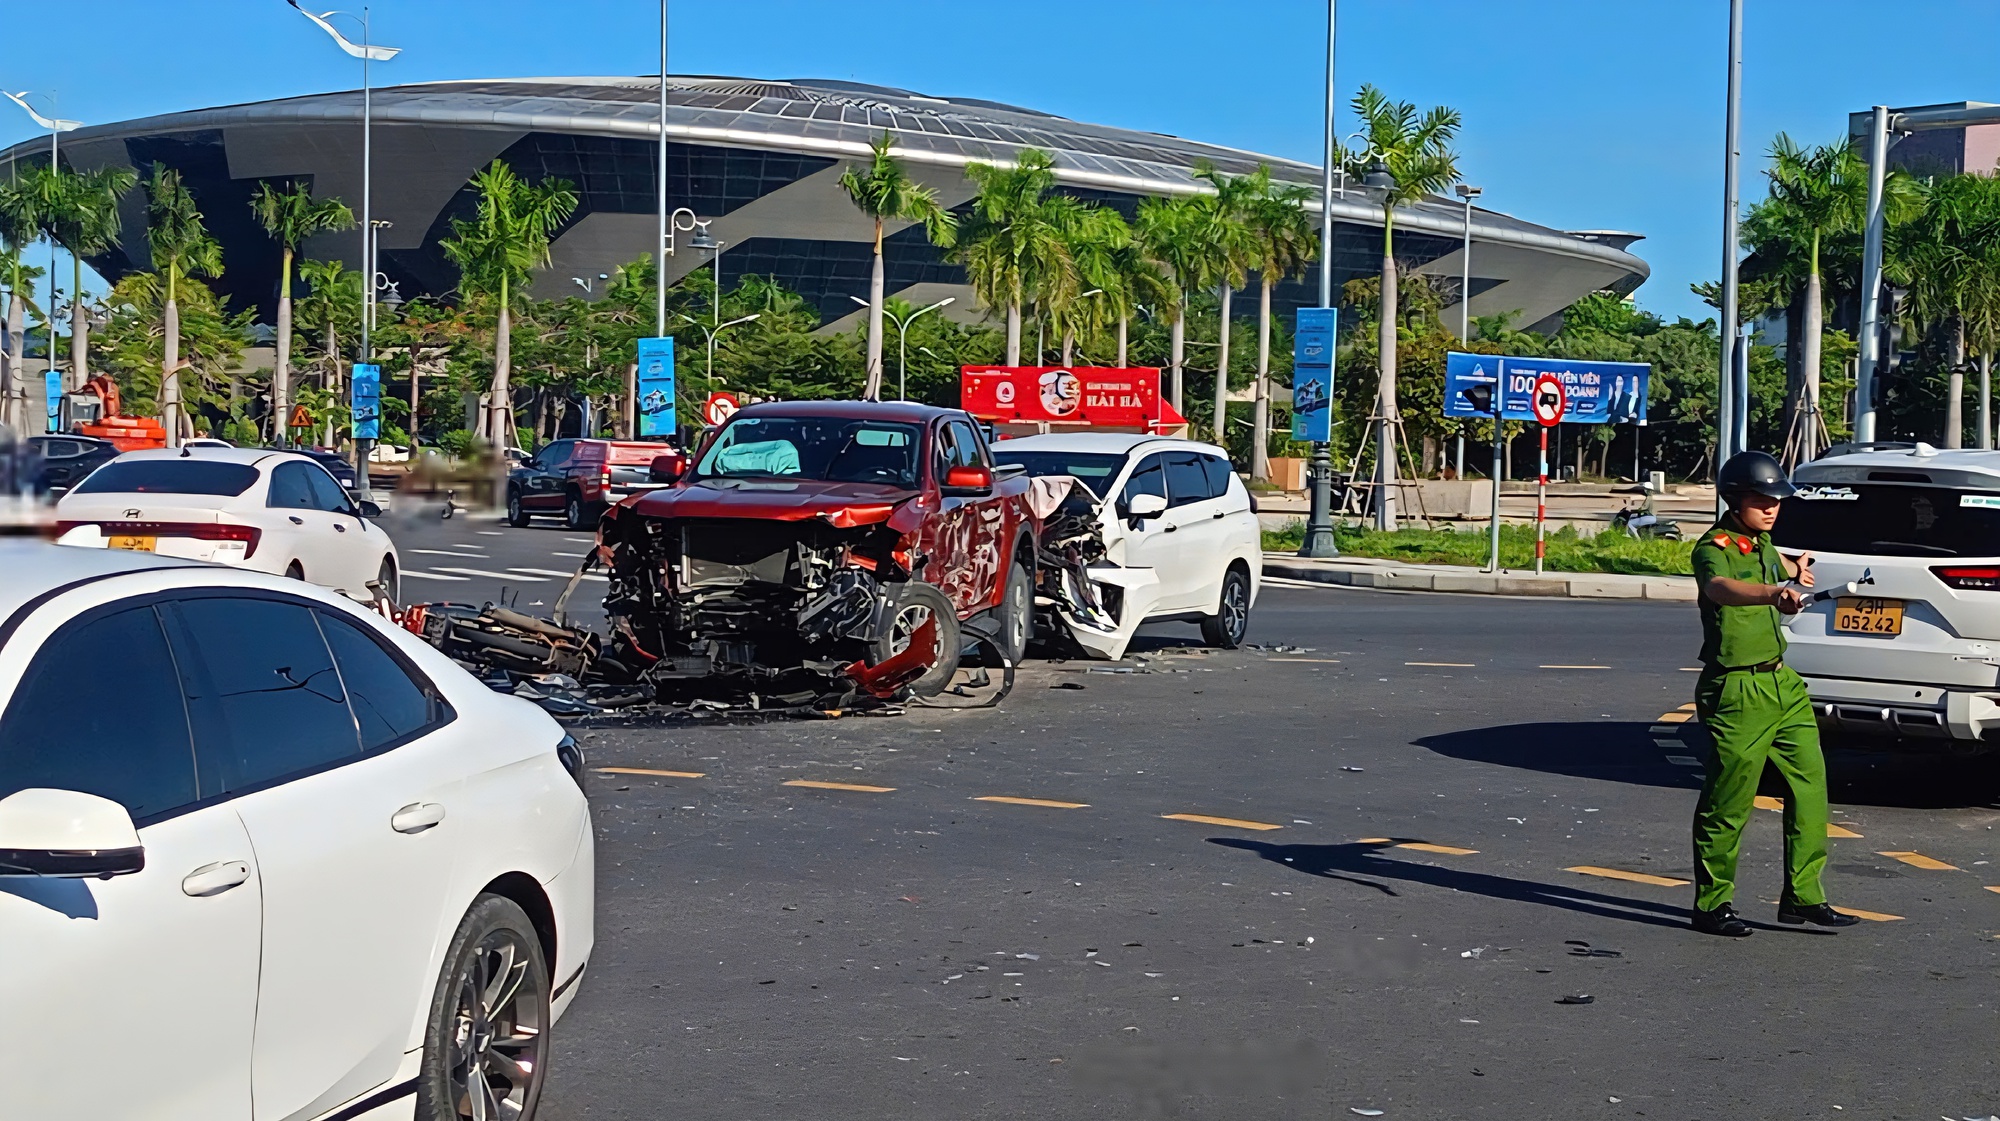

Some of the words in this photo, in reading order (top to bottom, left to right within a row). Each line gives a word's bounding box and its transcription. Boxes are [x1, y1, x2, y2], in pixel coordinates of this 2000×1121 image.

[1510, 375, 1536, 394] 100
[1540, 370, 1578, 384] UYÊN
[1565, 385, 1600, 398] DOANH
[1855, 599, 1884, 615] 43H
[1841, 615, 1894, 632] 052.42
